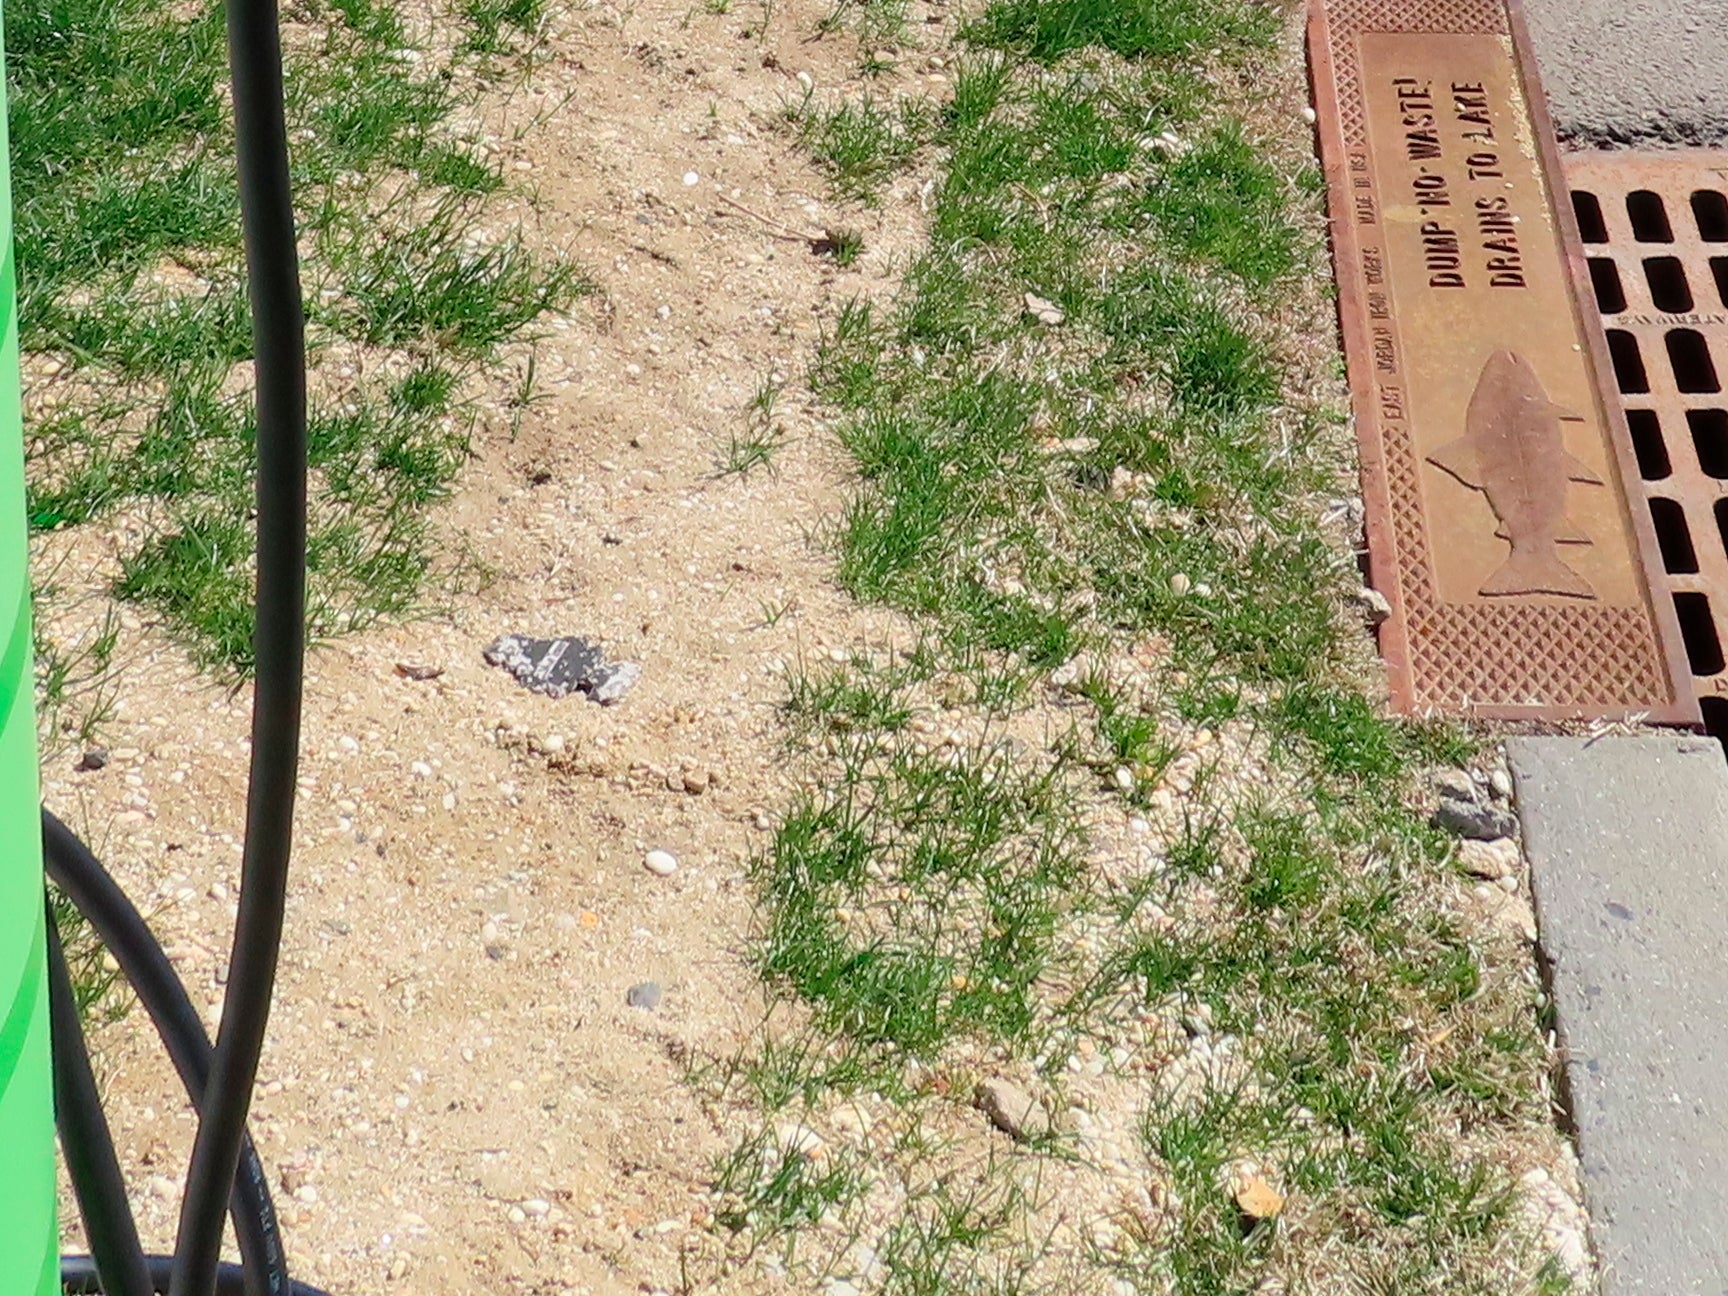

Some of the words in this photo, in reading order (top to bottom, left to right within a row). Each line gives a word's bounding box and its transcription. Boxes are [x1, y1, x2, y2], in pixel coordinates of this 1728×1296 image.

[1391, 77, 1442, 162] WASTE!
[1465, 152, 1503, 182] TO
[1419, 221, 1466, 289] DUMP
[1474, 196, 1526, 289] DRAINS
